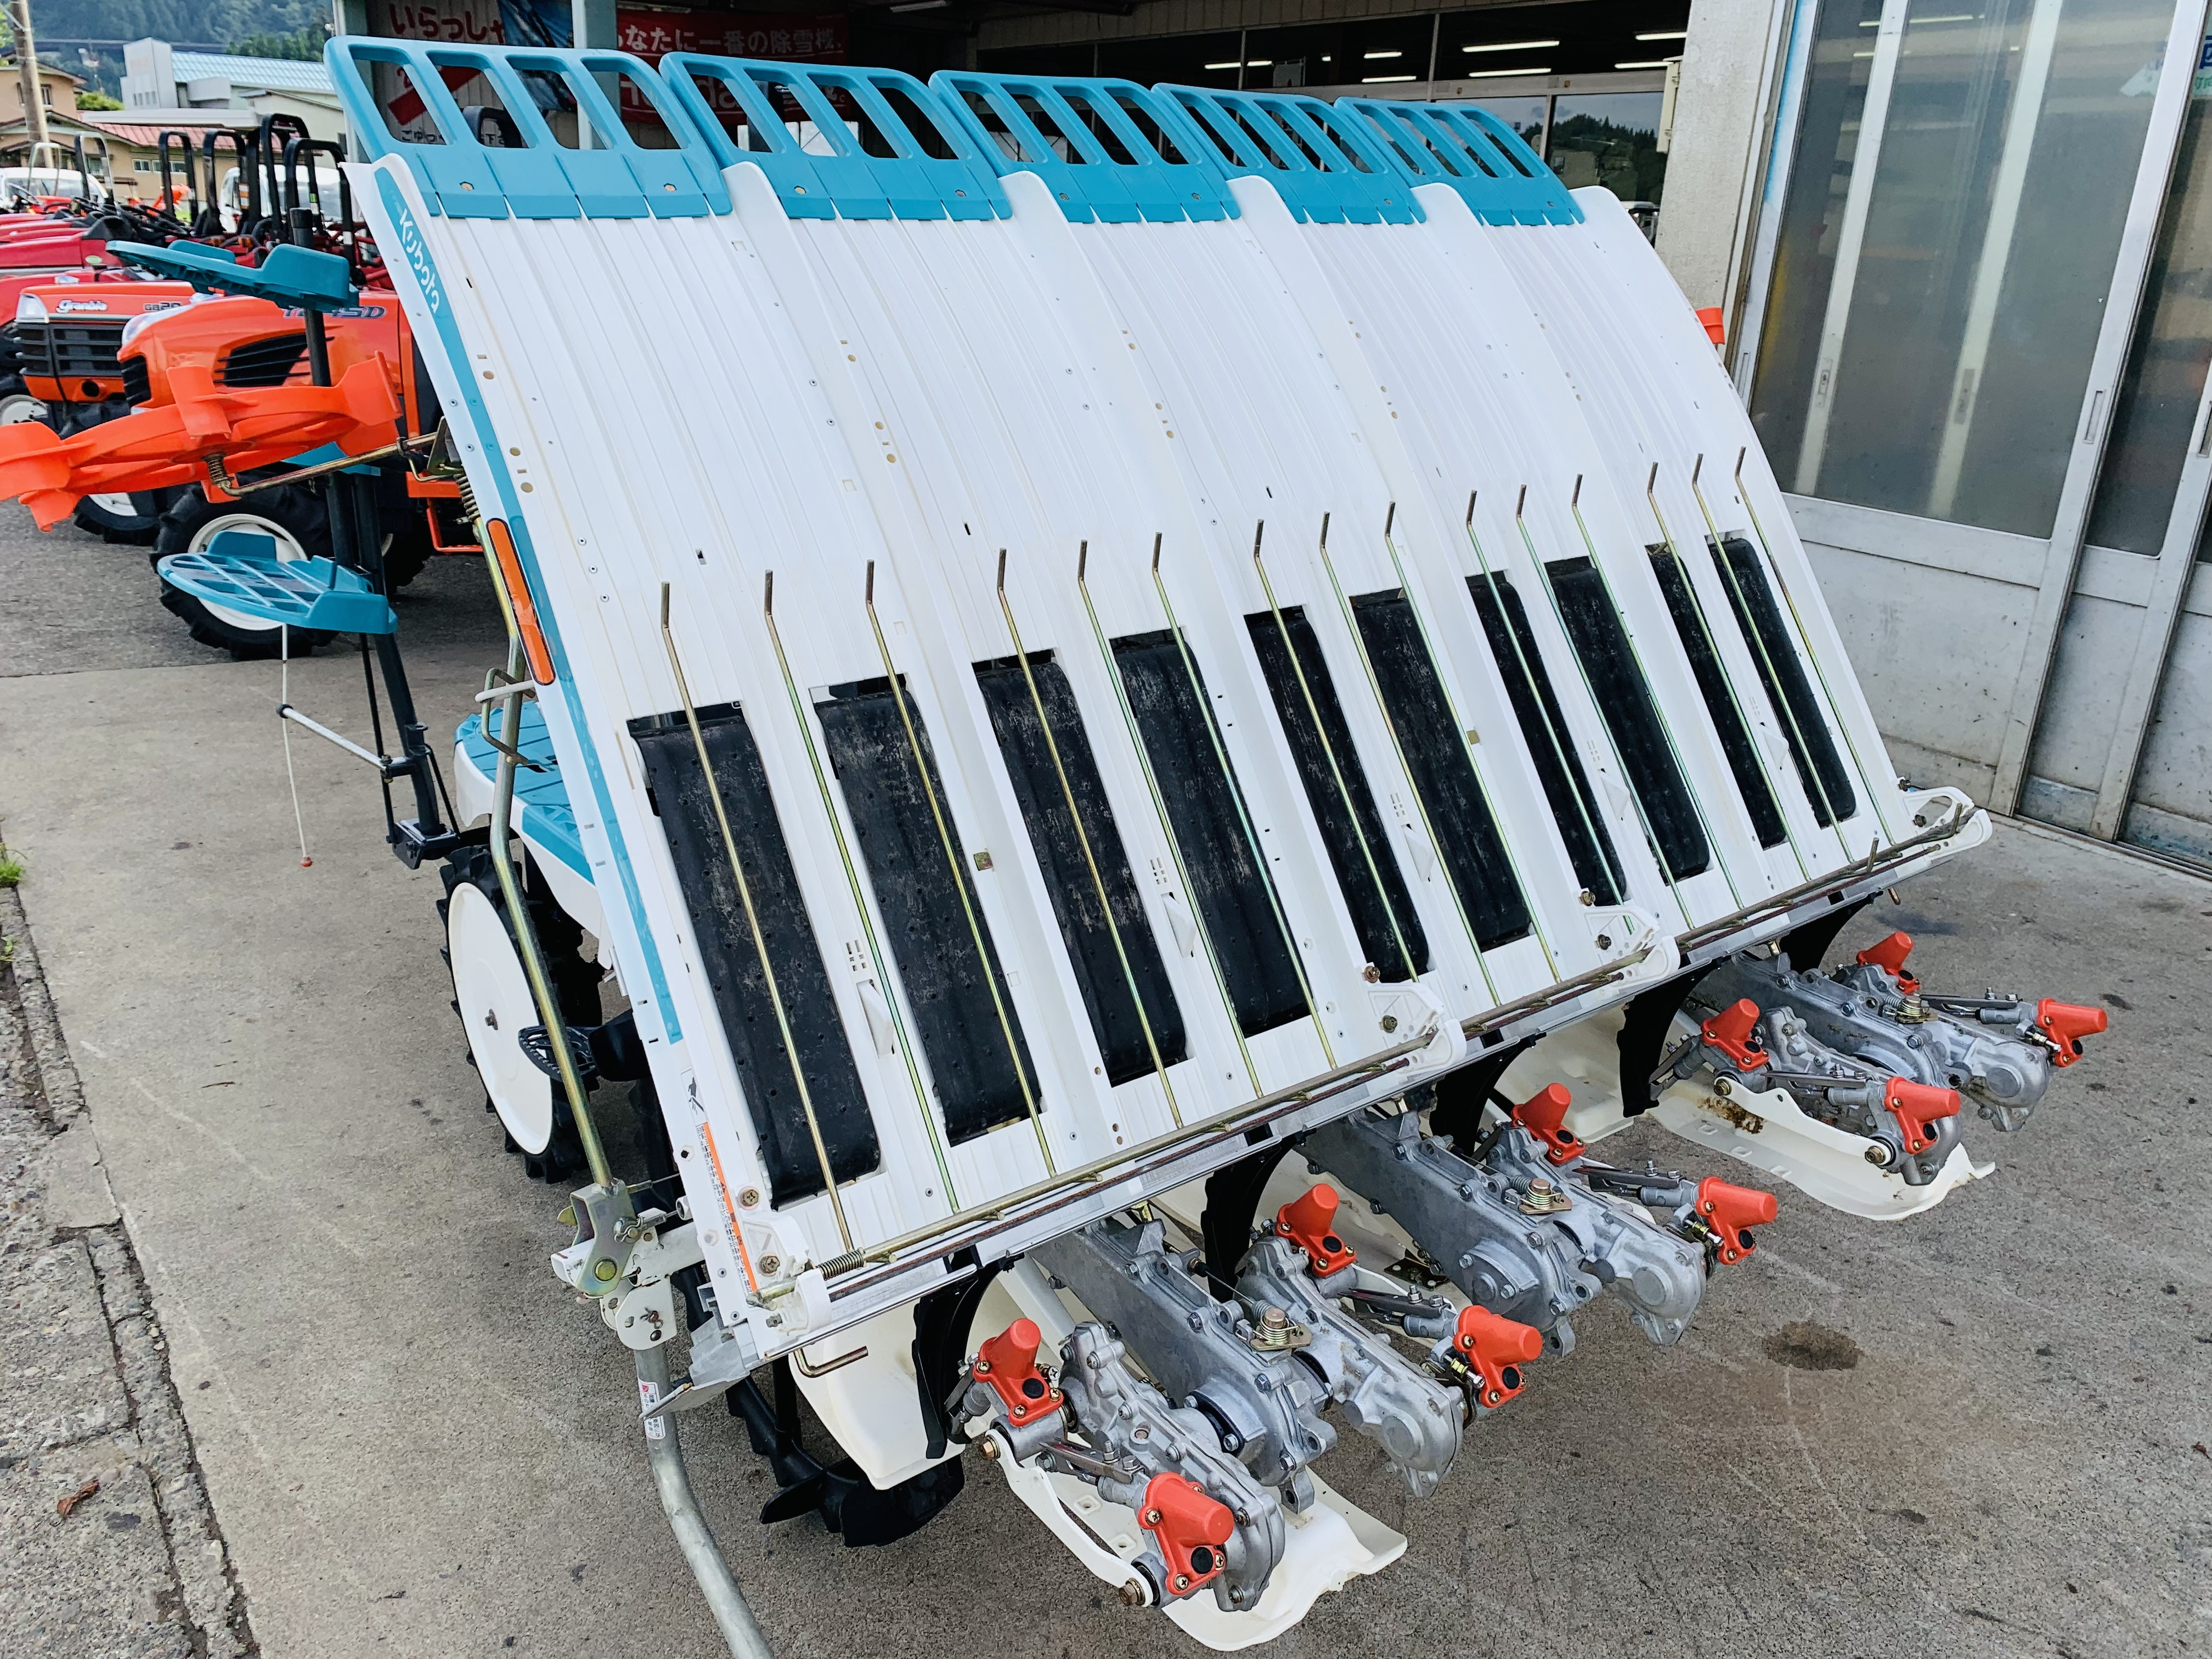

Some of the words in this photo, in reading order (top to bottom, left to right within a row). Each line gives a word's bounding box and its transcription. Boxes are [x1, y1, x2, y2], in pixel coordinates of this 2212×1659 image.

[618, 24, 842, 54] なたに一番の除雪機、
[399, 207, 440, 314] Kubota
